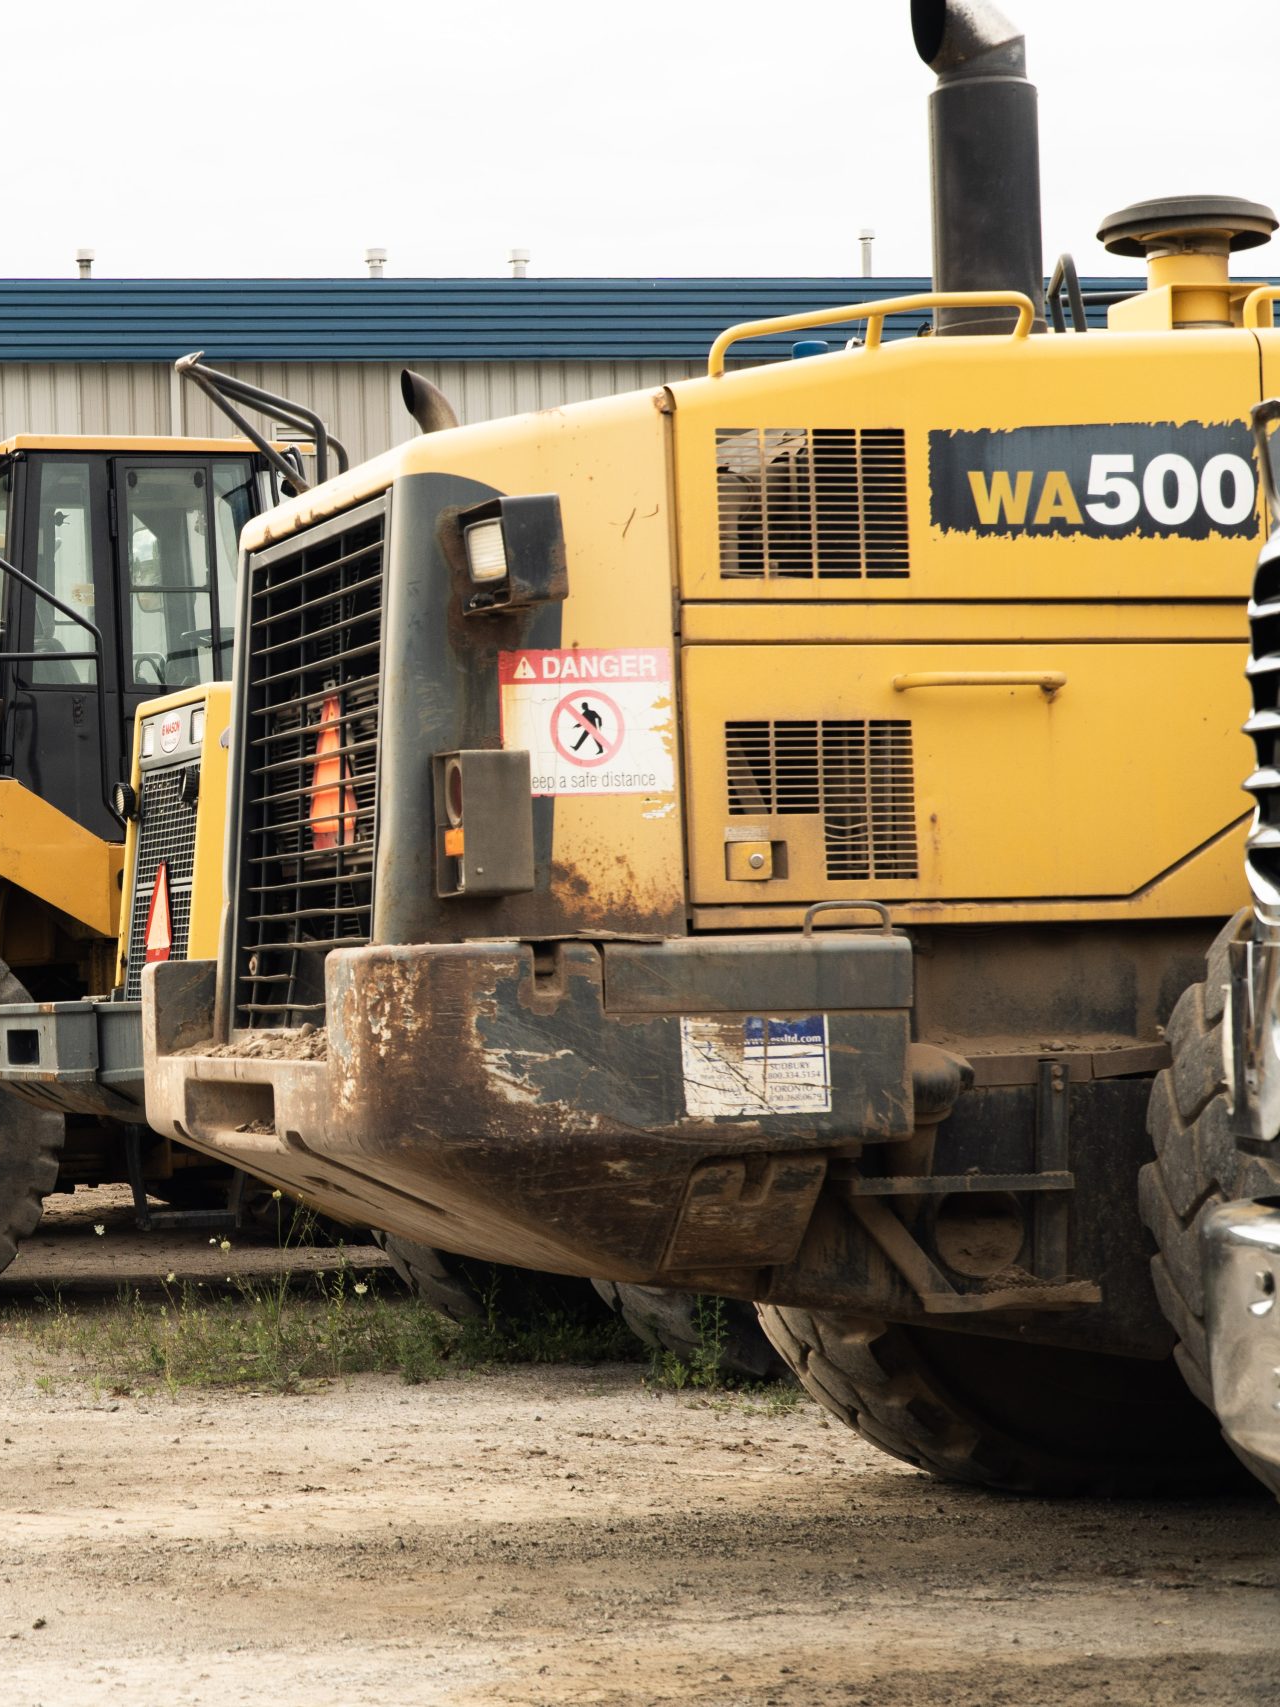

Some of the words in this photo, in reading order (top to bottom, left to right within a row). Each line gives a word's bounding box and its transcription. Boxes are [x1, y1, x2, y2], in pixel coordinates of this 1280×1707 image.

[967, 453, 1255, 526] WA500
[542, 655, 657, 679] DANGER
[531, 775, 555, 791] eep
[559, 775, 567, 788] a
[570, 771, 598, 788] safe
[601, 771, 657, 788] distance
